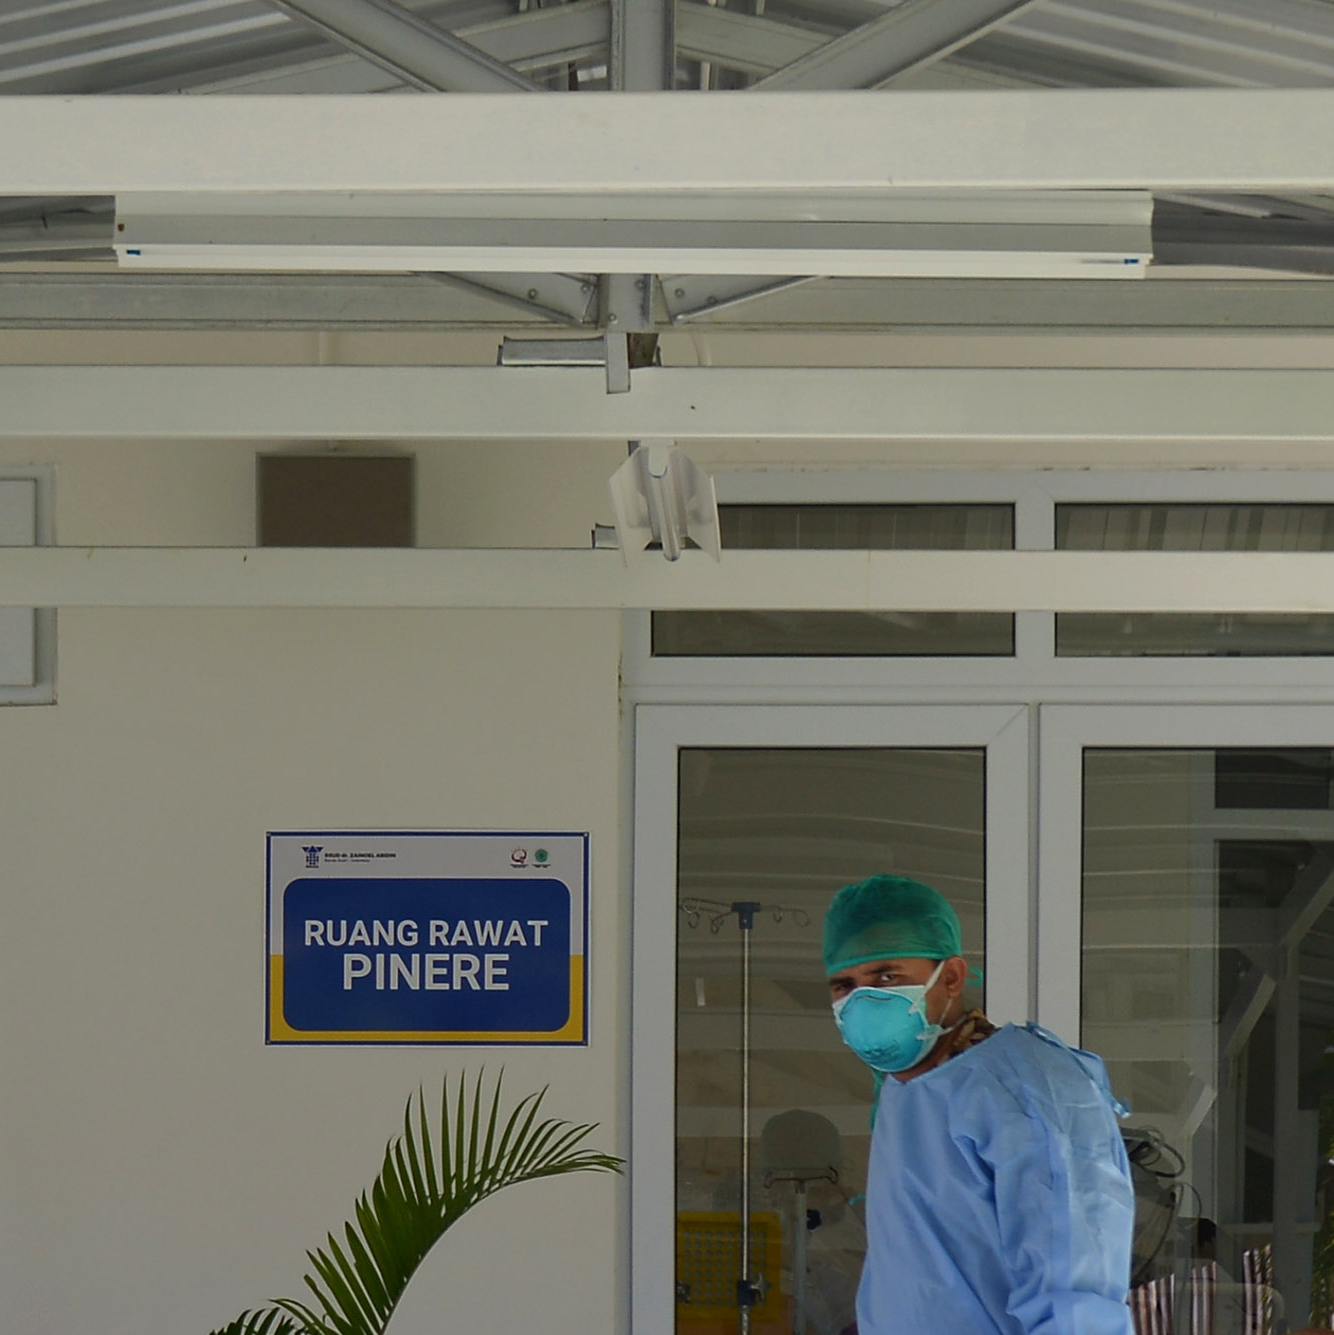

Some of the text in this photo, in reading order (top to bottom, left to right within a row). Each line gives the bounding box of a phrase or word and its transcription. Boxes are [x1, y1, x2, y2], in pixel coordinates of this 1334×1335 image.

[304, 919, 549, 947] RUANG RAWAT
[343, 953, 510, 991] PINERE
